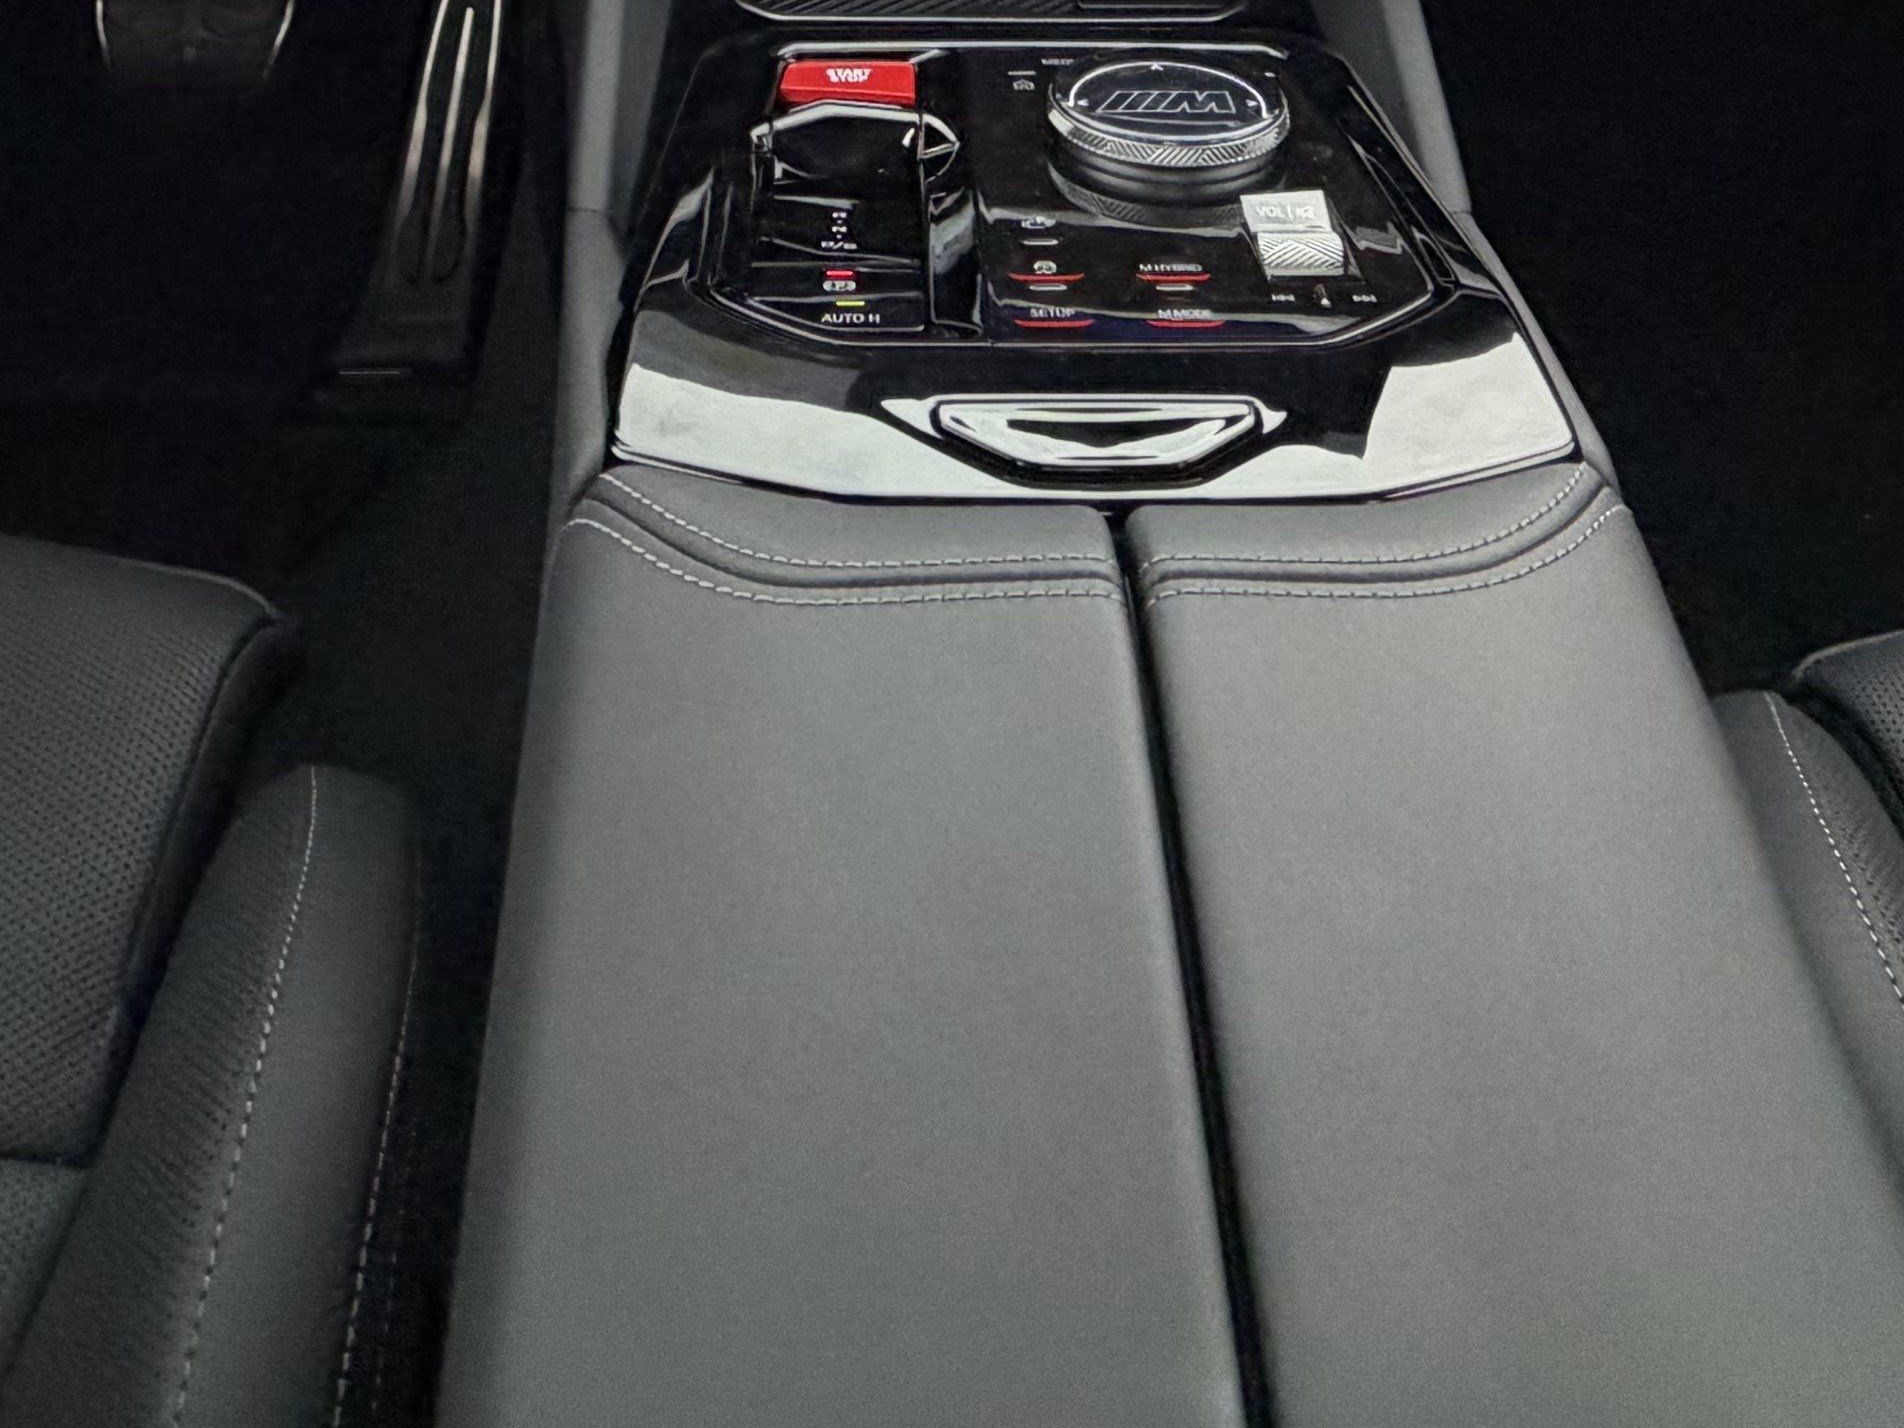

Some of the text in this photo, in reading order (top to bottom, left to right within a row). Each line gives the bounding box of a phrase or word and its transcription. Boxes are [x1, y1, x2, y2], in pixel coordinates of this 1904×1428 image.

[825, 67, 873, 76] START
[1255, 204, 1287, 219] VOL
[820, 311, 882, 325] AUTO H
[1028, 306, 1078, 319] SETUP
